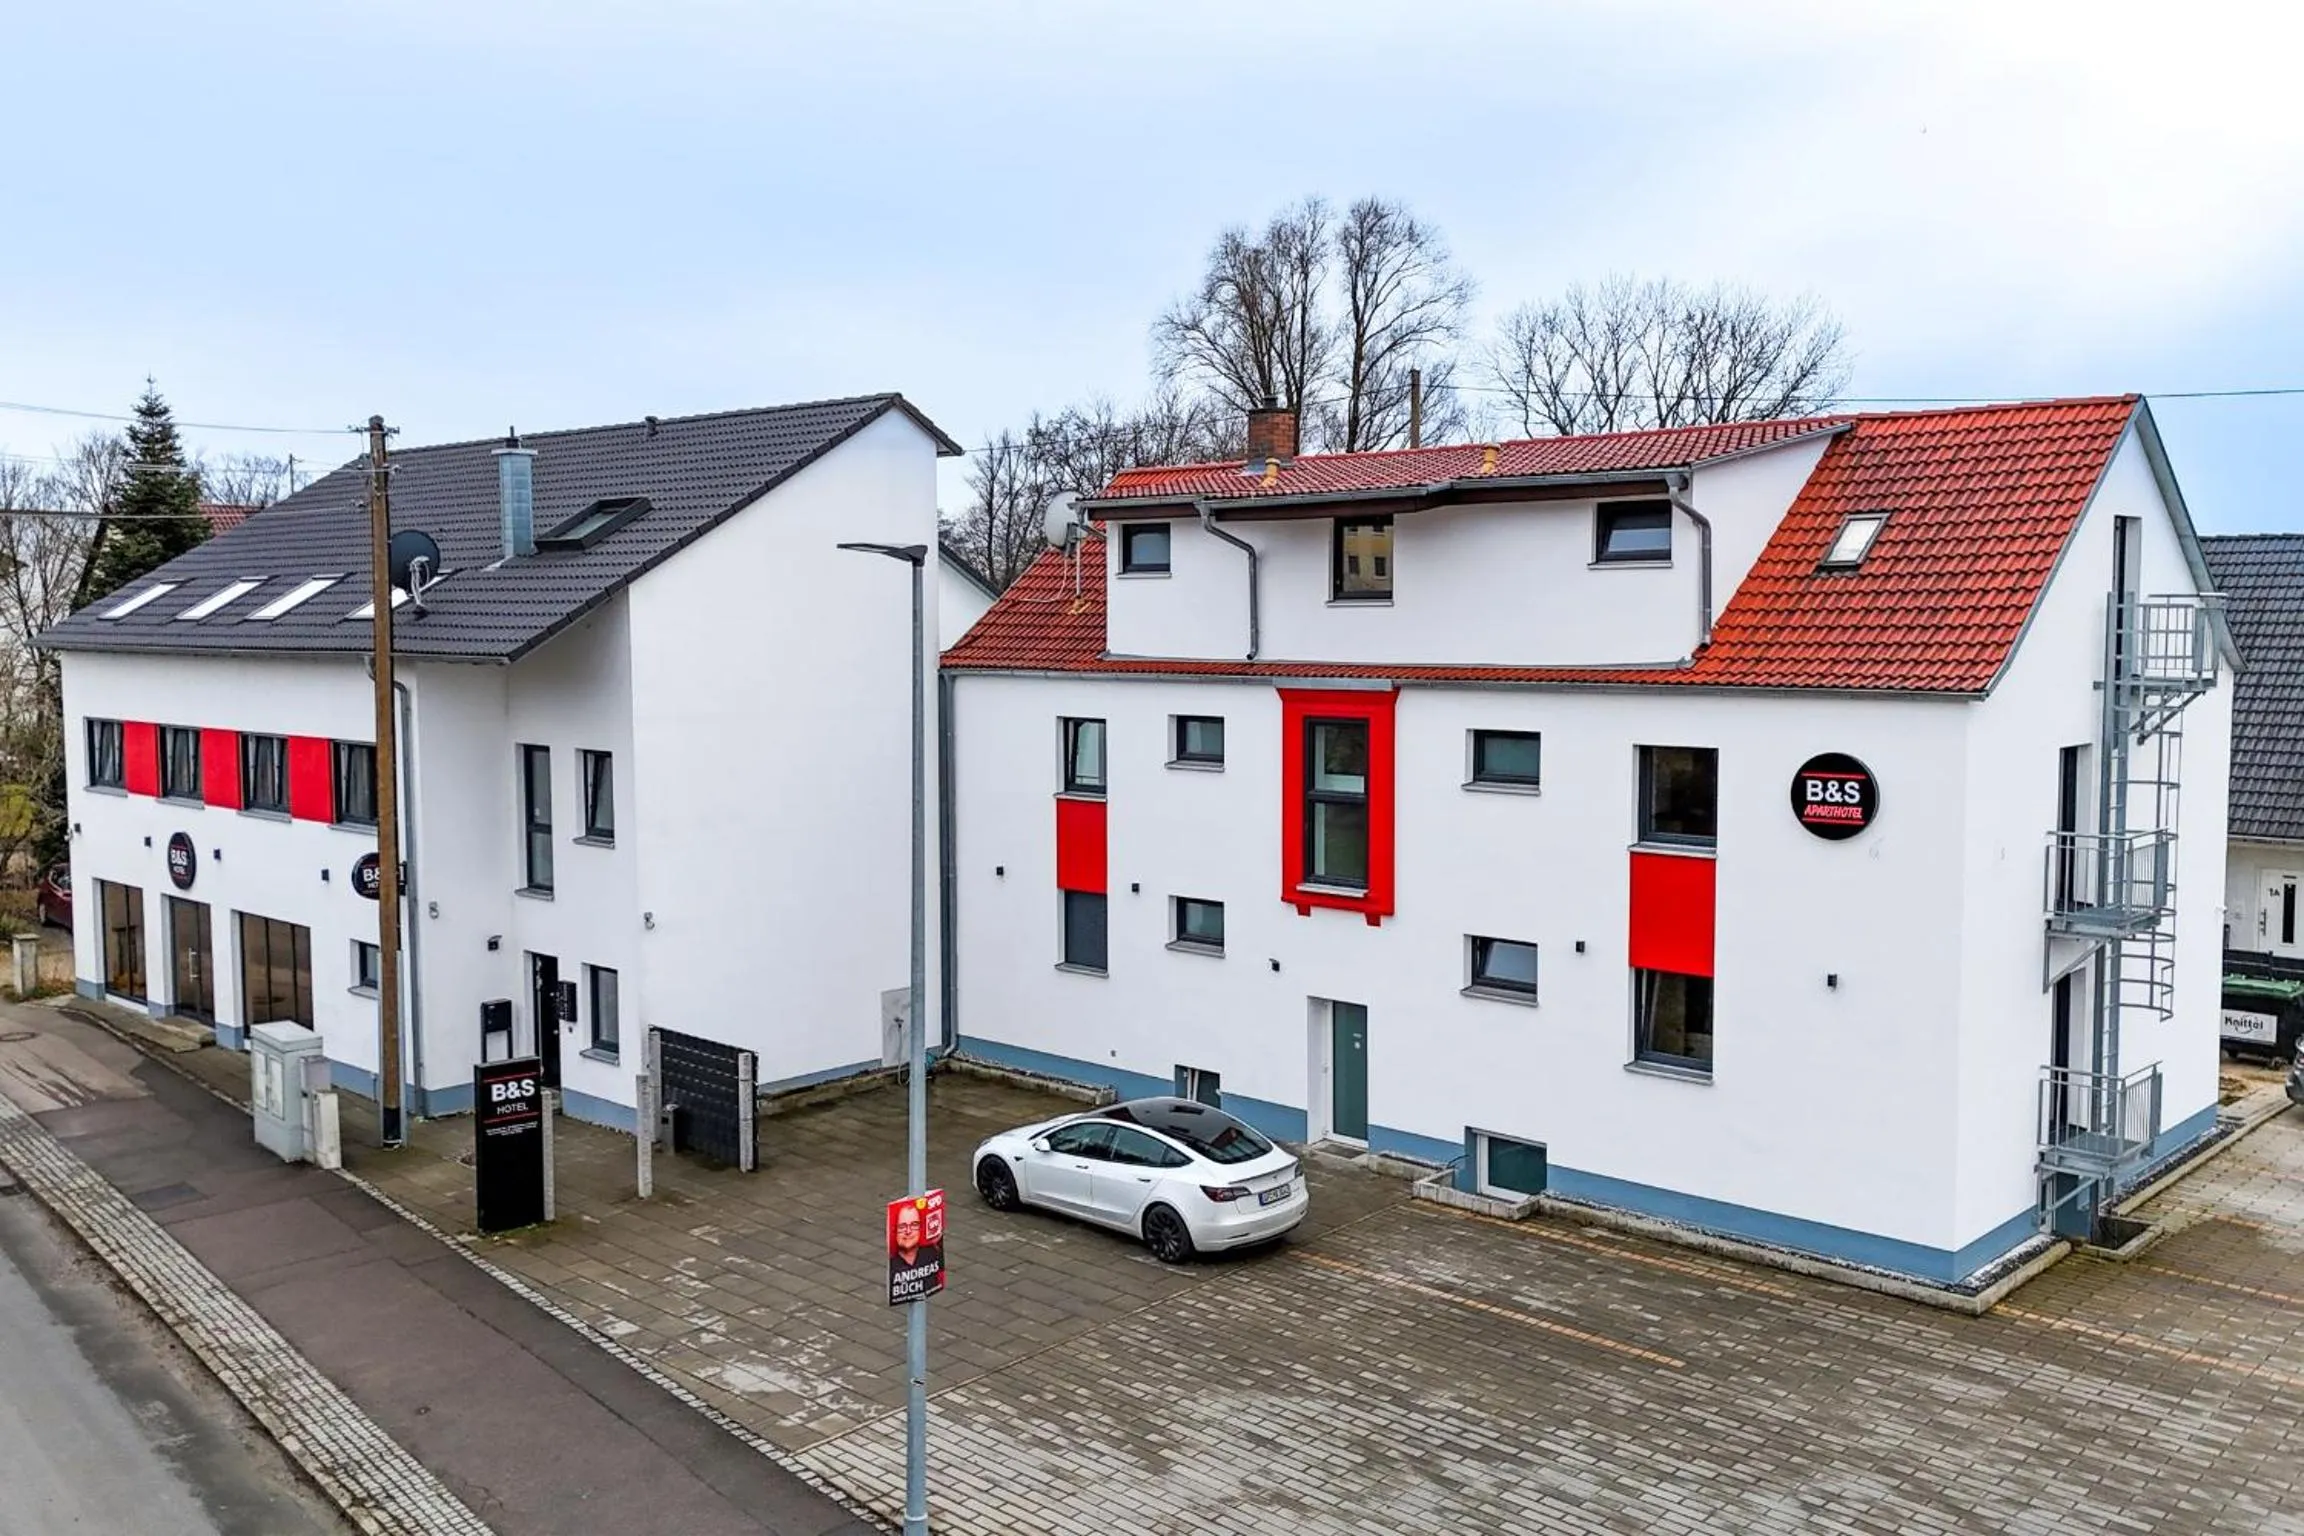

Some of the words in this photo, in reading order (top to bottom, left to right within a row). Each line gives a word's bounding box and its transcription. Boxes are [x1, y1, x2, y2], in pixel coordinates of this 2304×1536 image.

[1806, 779, 1861, 804] B&S
[1804, 804, 1863, 819] APARTHOTEL
[170, 848, 188, 866] B&S
[491, 1078, 536, 1103] B&S
[496, 1102, 529, 1116] HOTEL
[927, 1195, 942, 1209] SPD
[893, 1260, 940, 1284] ANDREAS
[892, 1280, 924, 1297] BÜCH
